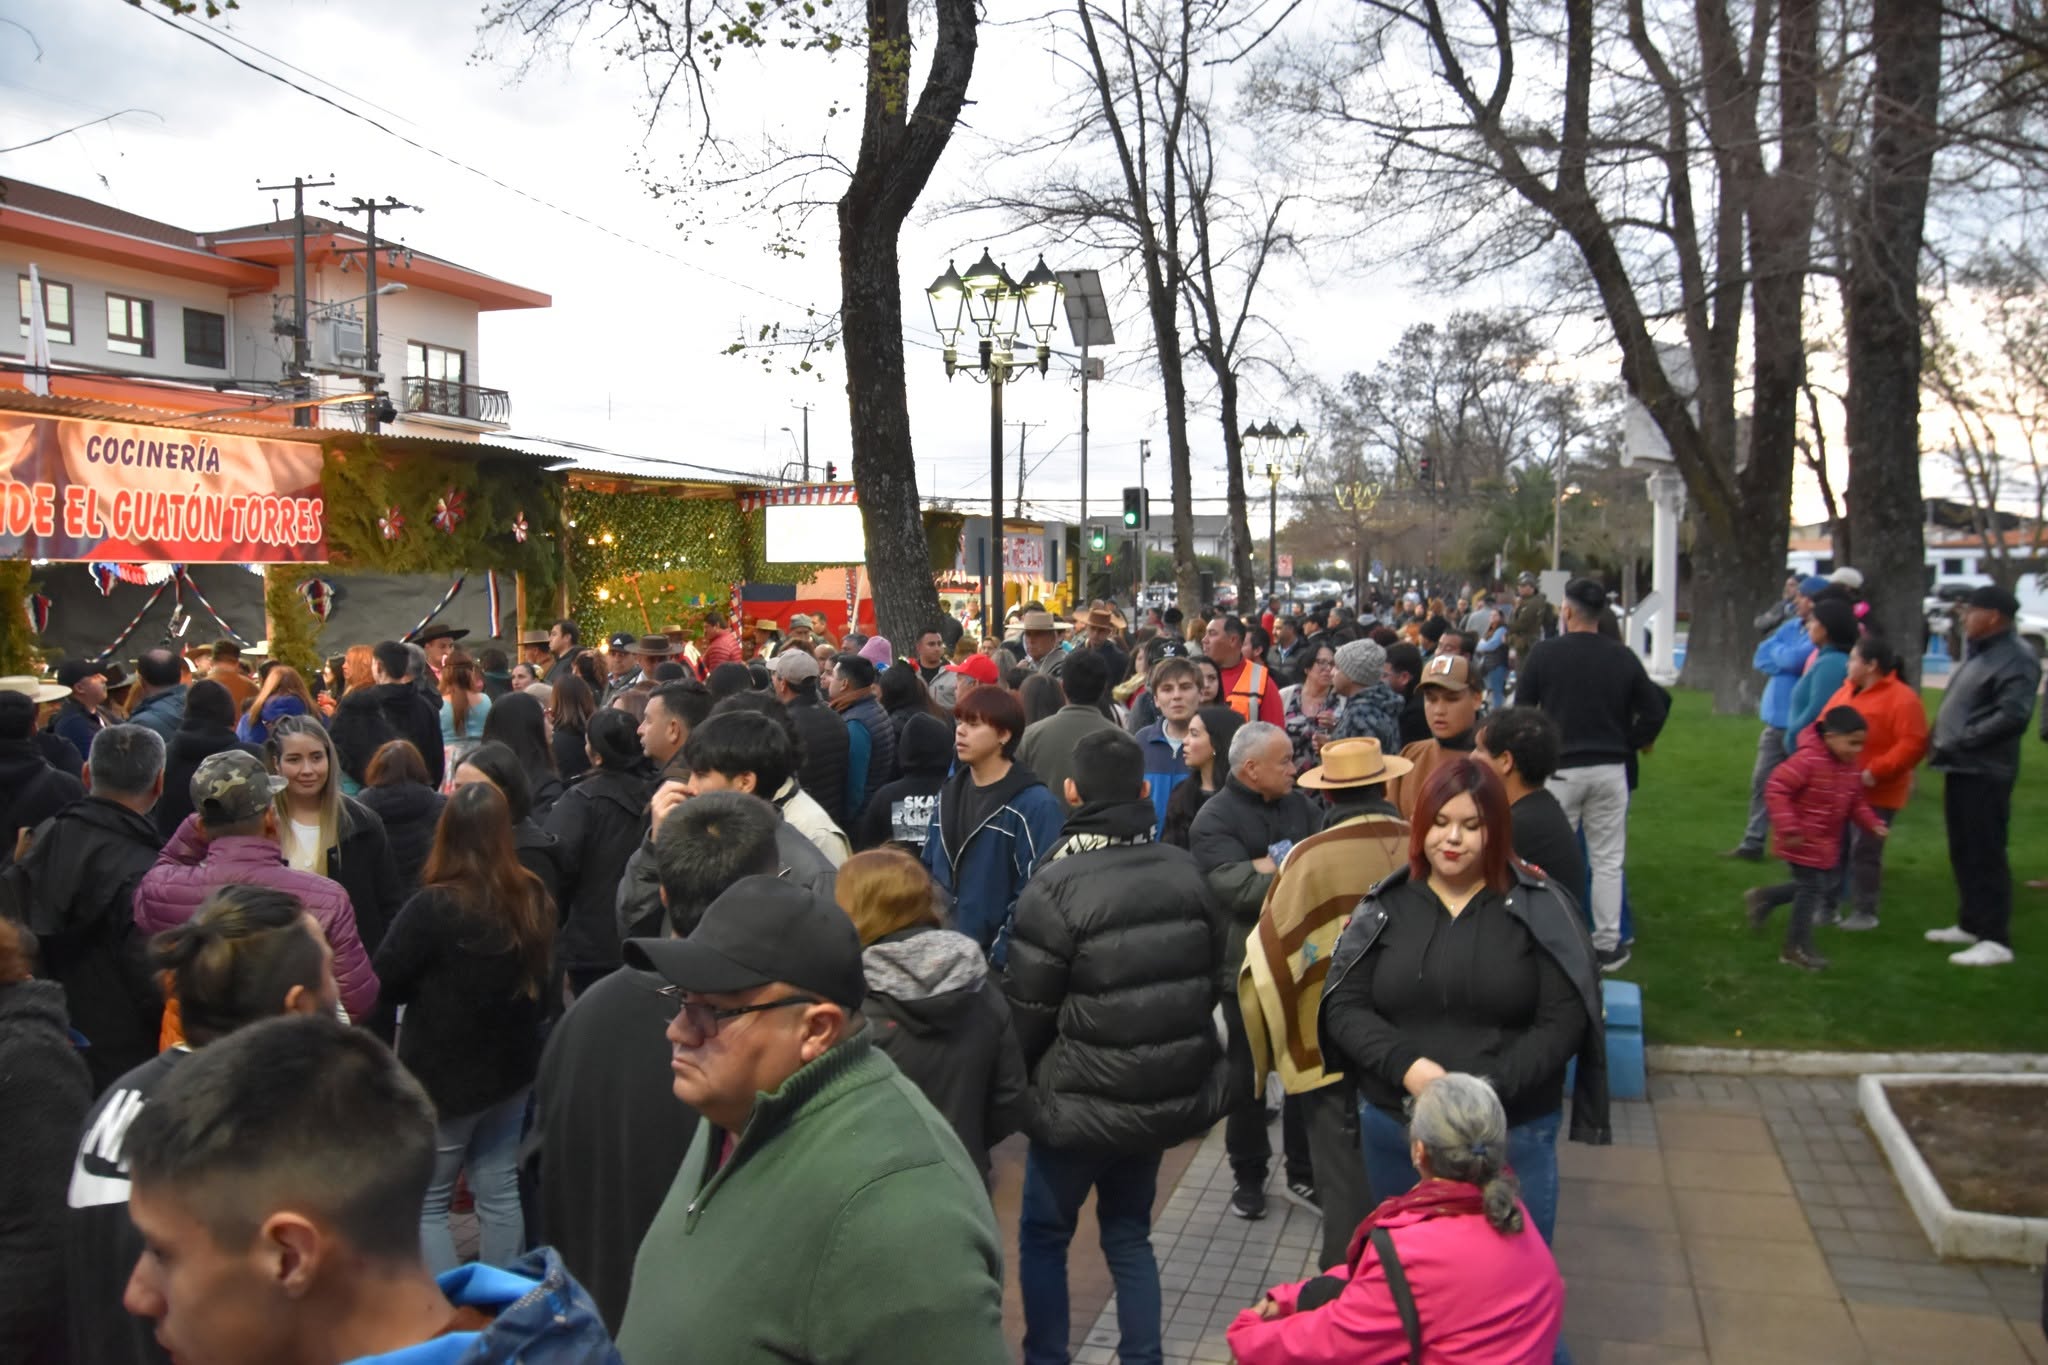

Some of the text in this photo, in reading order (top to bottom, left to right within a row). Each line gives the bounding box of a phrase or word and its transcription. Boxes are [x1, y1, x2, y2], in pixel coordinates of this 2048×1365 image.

[86, 435, 220, 473] COCINERÍA
[0, 481, 323, 547] DE EL GUATÓN TORRES
[904, 795, 939, 809] SKA
